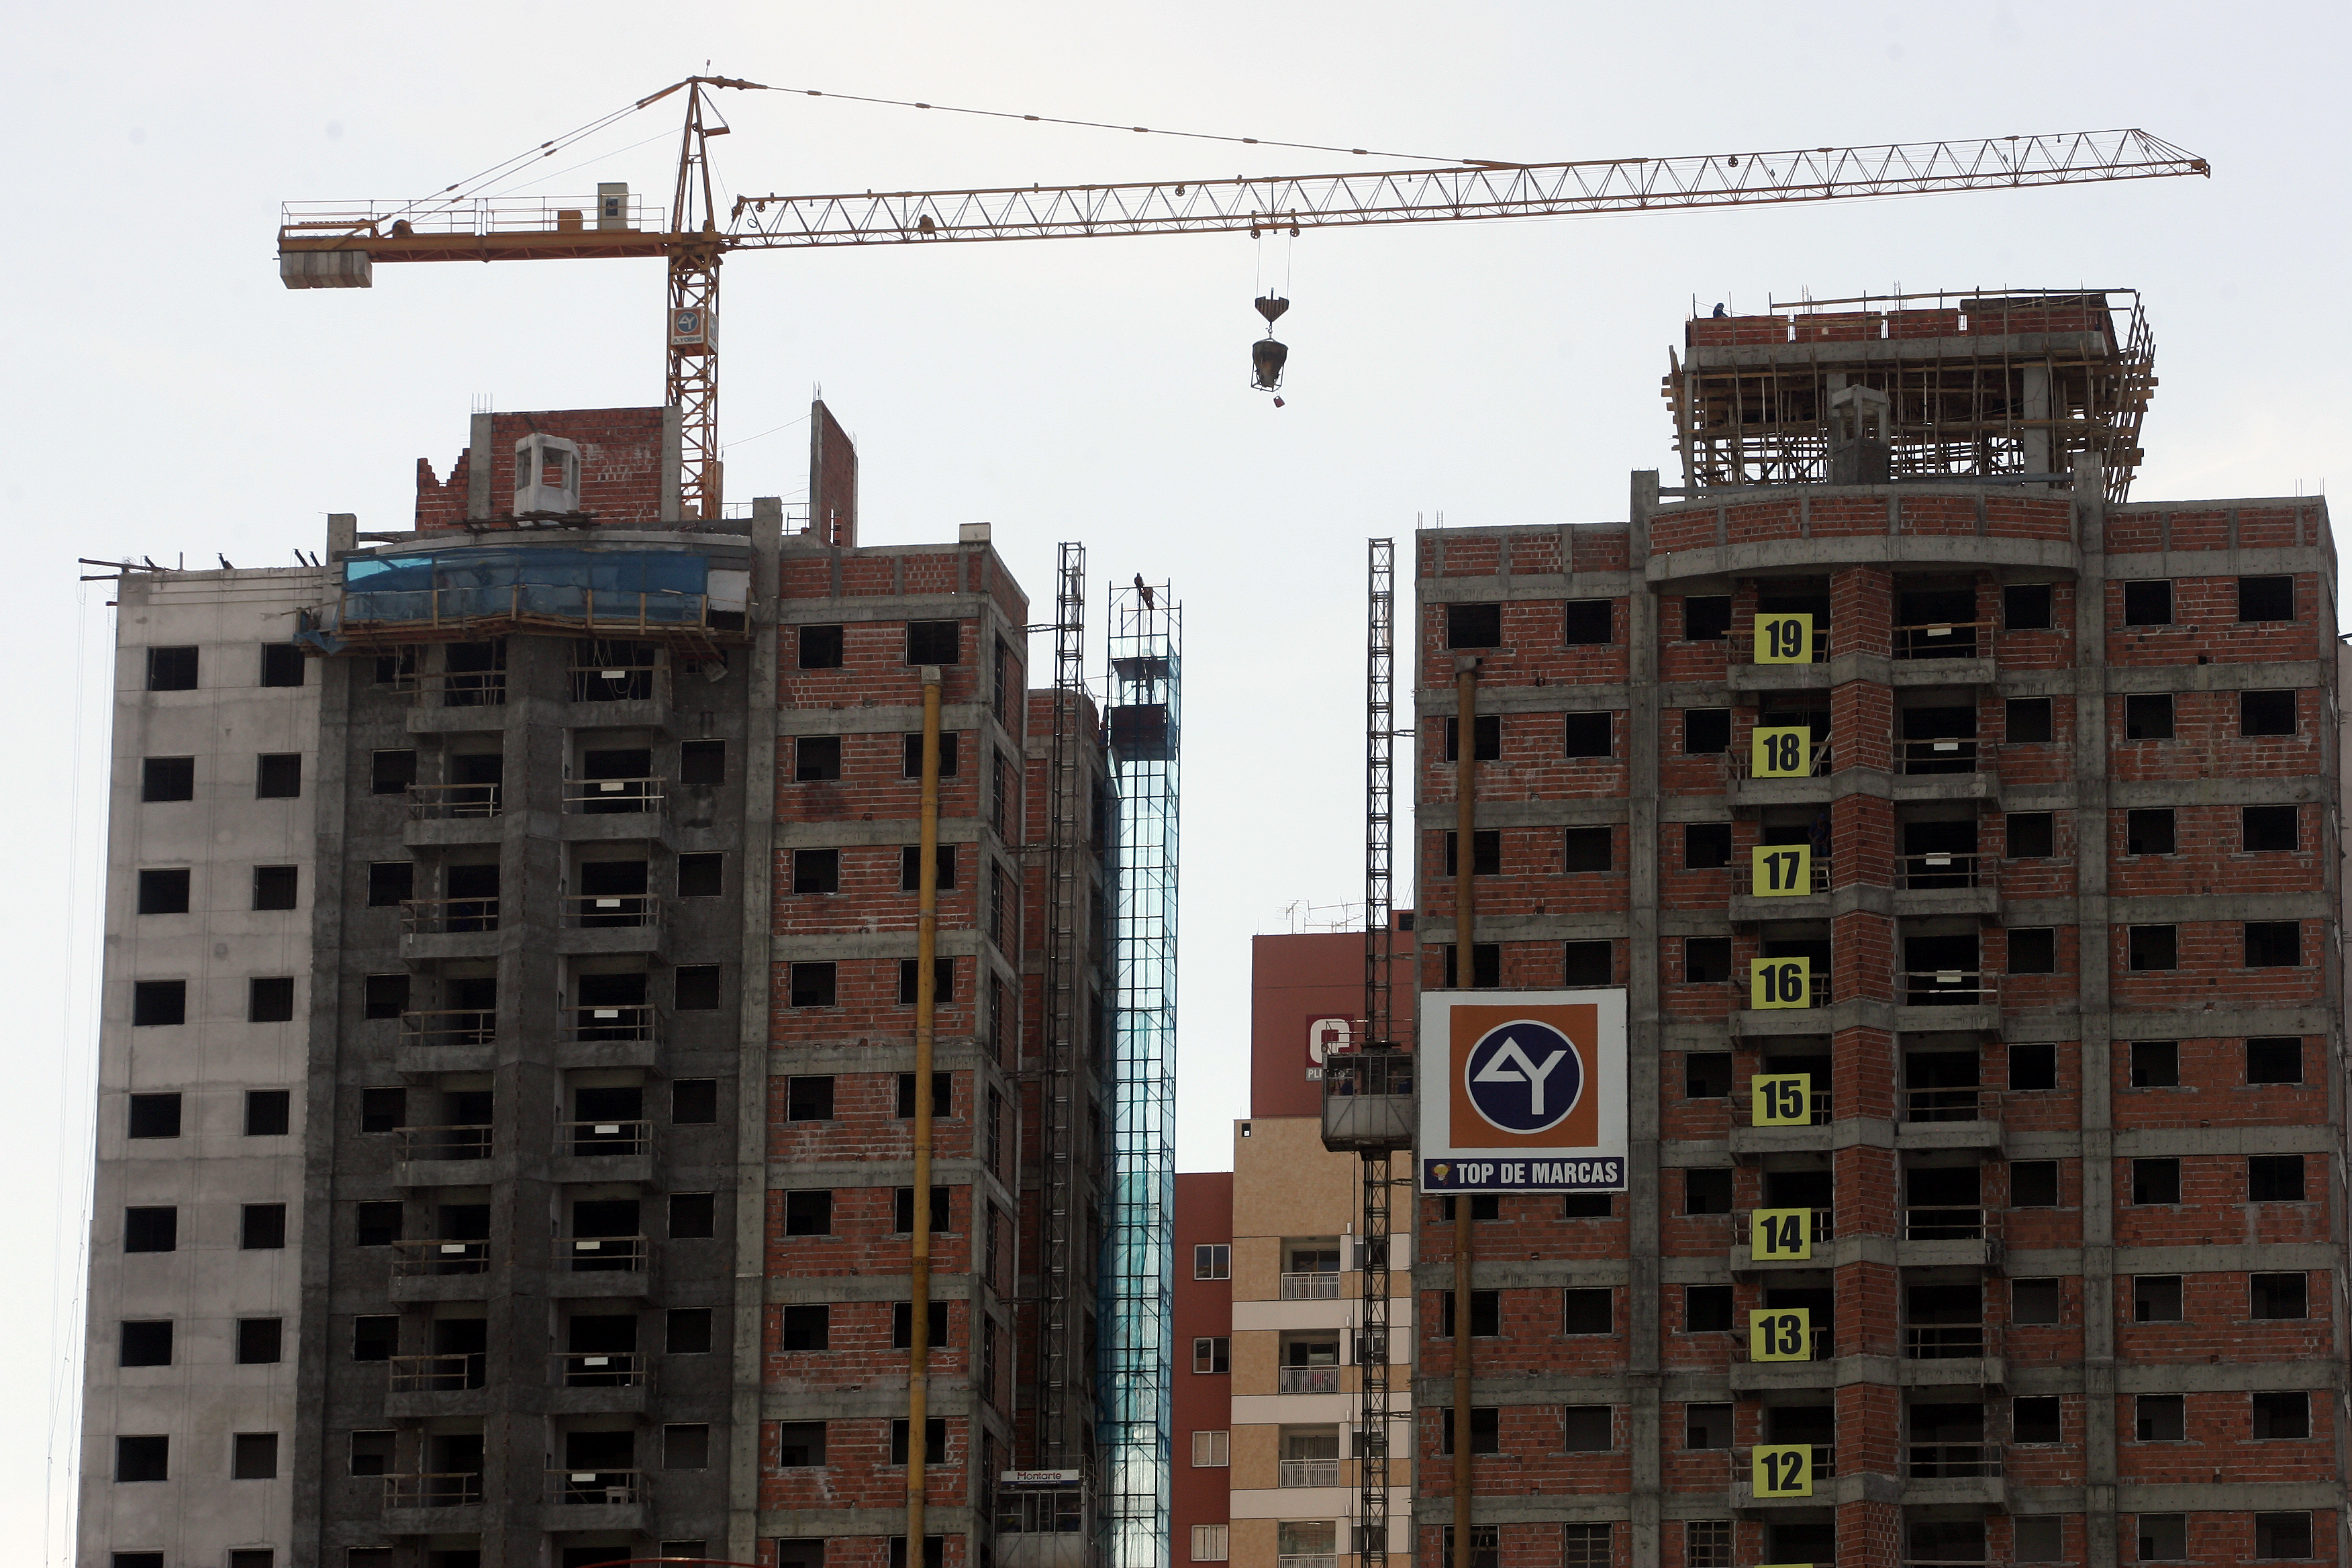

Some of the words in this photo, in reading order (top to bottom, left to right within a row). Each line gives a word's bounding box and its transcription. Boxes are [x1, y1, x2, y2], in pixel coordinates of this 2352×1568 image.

[1765, 620, 1802, 657] 19
[1763, 734, 1800, 771] 18
[1763, 852, 1800, 889] 17
[1759, 964, 1802, 1002] 16
[1472, 1036, 1567, 1116] AY
[1760, 1080, 1803, 1118] 15
[1457, 1163, 1494, 1183] TOP
[1500, 1163, 1526, 1183] DE
[1532, 1162, 1618, 1183] MARCAS
[1761, 1216, 1803, 1253] 14
[1759, 1314, 1802, 1355] 13
[1017, 1471, 1062, 1480] Montarte
[1761, 1451, 1803, 1491] 12
